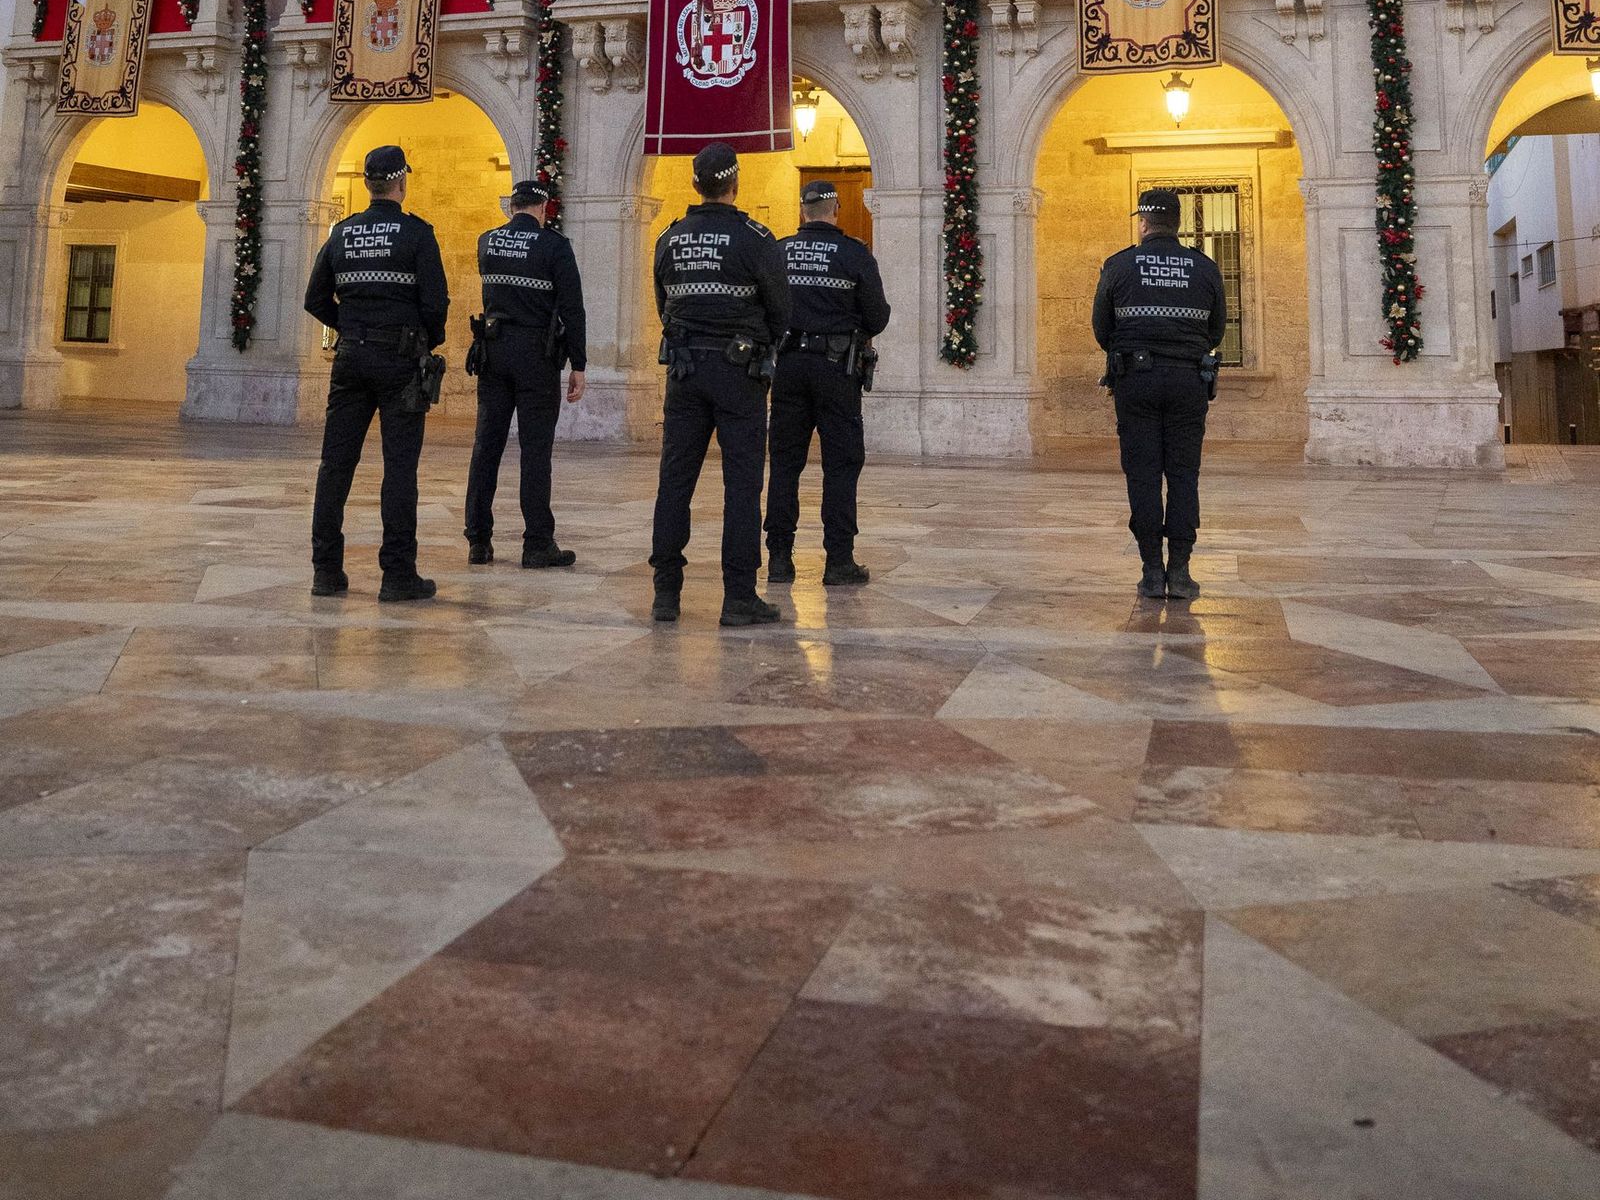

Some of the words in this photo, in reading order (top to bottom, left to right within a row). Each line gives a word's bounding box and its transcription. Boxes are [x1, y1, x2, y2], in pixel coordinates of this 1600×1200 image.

[342, 223, 401, 236] POLICIA
[489, 229, 539, 240] POLICIA
[344, 235, 393, 248] LOCAL
[488, 237, 530, 250] LOCAL
[669, 233, 731, 246] POLICIA
[785, 241, 838, 253] POLICIA
[345, 249, 391, 259] ALMERIA
[487, 248, 528, 259] ALMERIA
[672, 247, 723, 260] LOCAL
[787, 251, 831, 263] LOCAL
[674, 261, 721, 271] ALMERIA
[787, 262, 829, 272] ALMERIA
[1135, 255, 1194, 267] POLICIA
[1140, 265, 1190, 278] LOCAL
[1141, 278, 1189, 288] ALMERIA
